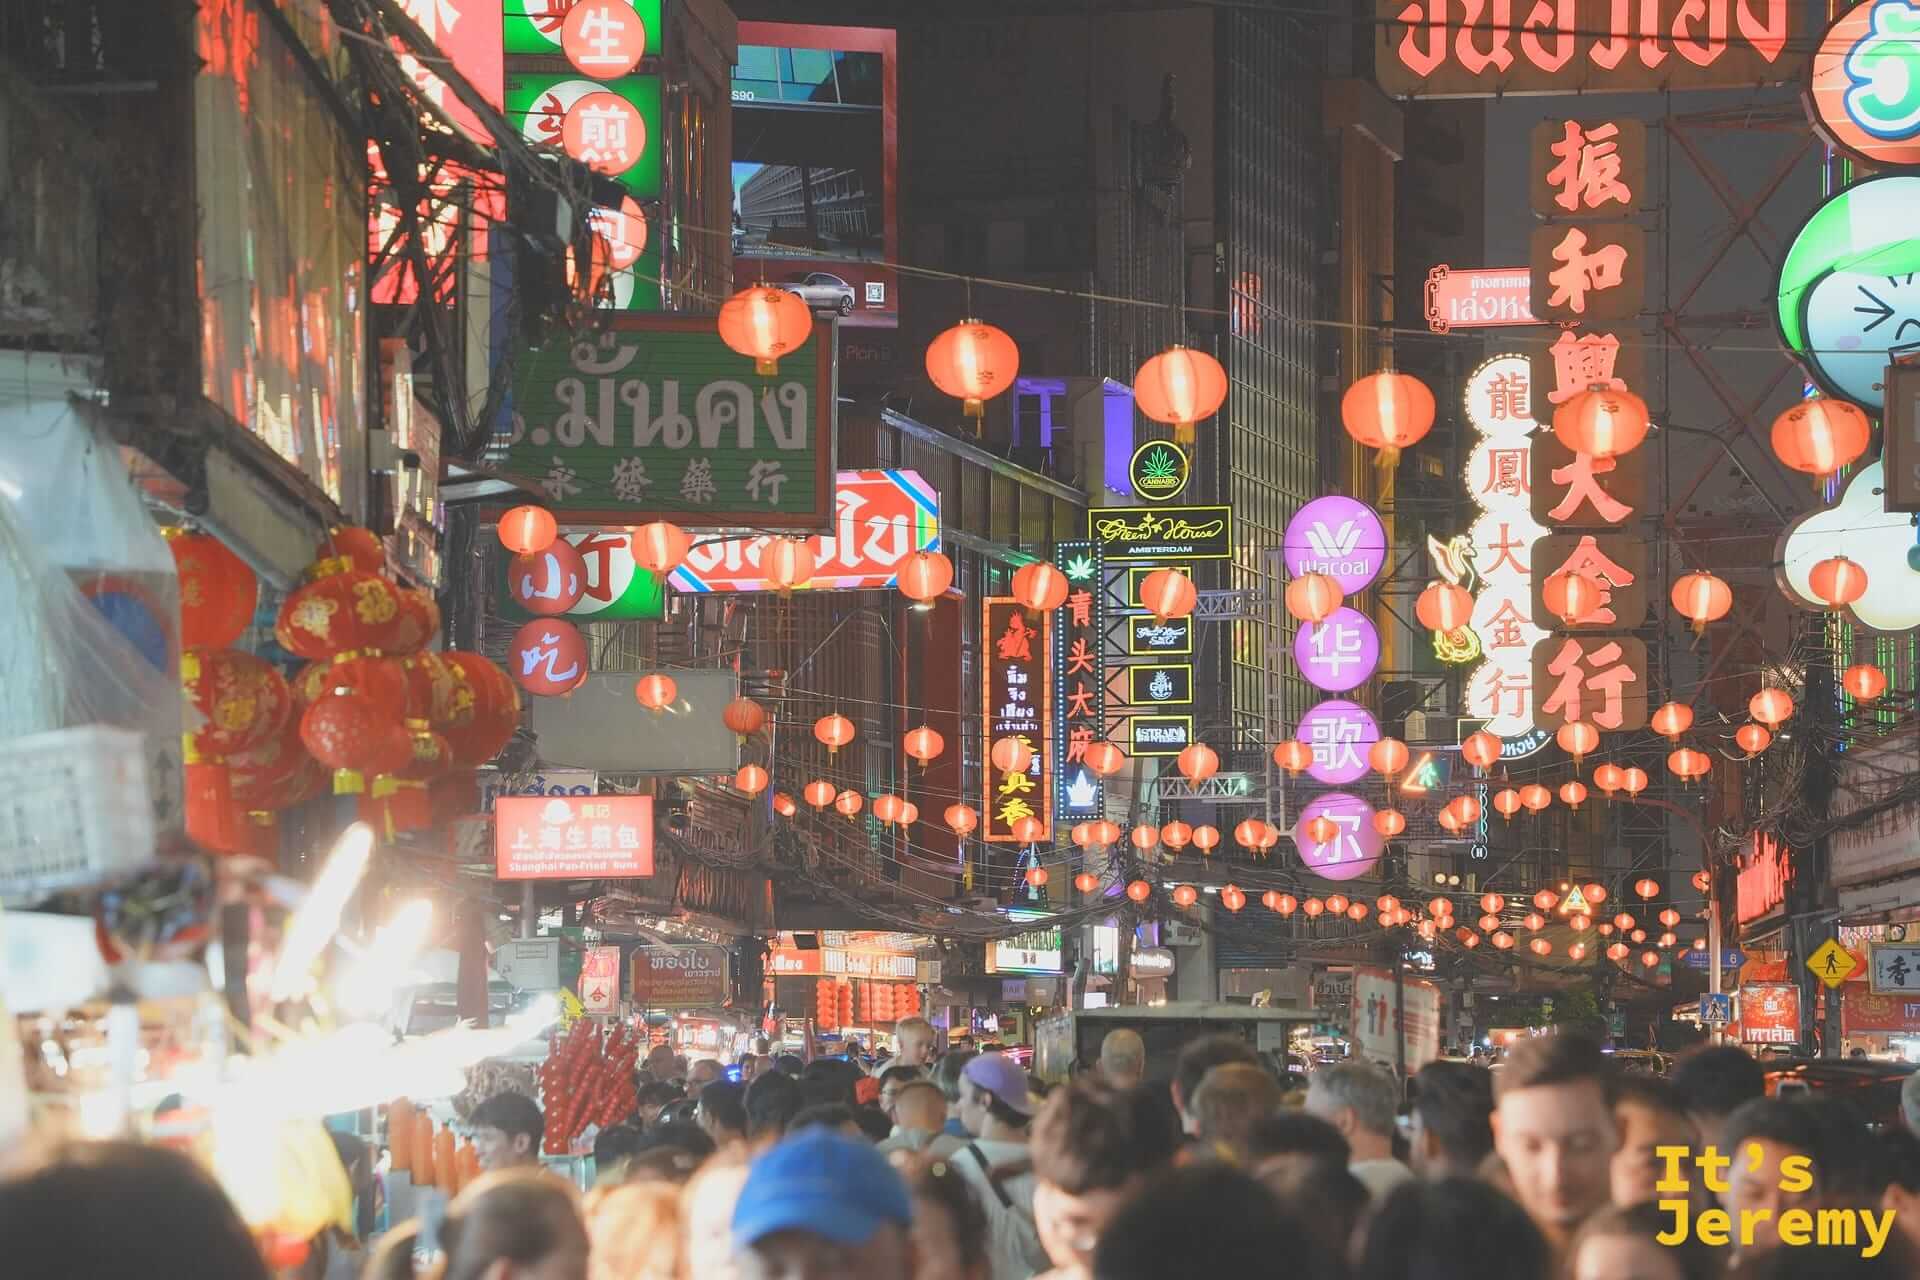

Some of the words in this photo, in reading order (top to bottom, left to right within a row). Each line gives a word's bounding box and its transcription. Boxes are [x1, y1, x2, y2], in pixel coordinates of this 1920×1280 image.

[731, 90, 754, 102] S90
[512, 331, 808, 450] .มั่นคง
[1128, 546, 1193, 554] AMSTERDAM
[1299, 559, 1369, 577] Wacoal
[509, 861, 556, 872] Shanghai
[559, 862, 607, 872] Pan-Fried
